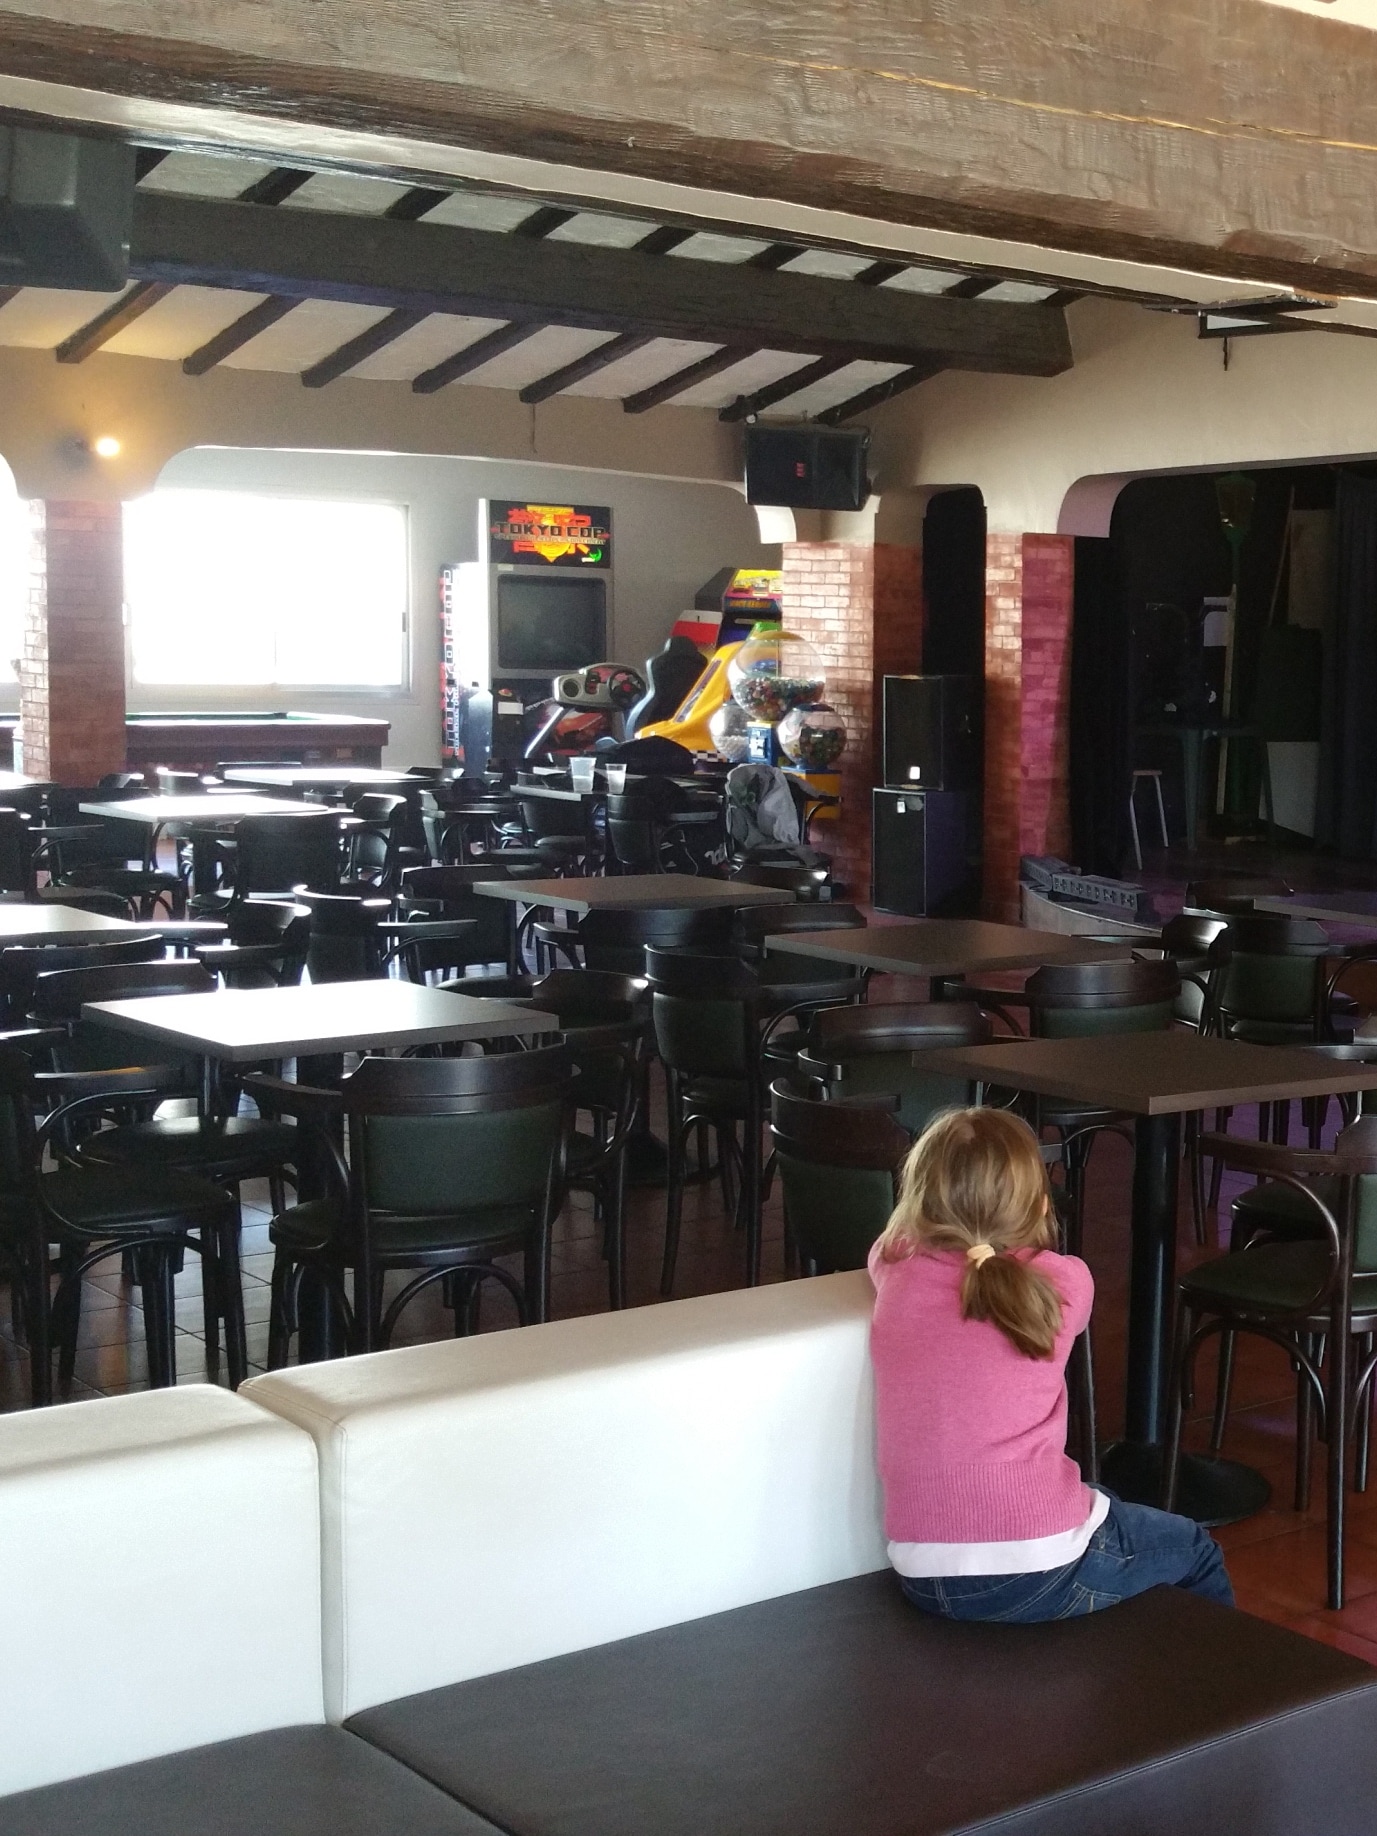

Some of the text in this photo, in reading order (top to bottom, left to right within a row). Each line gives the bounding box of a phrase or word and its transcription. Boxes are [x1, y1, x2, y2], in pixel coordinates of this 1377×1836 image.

[494, 522, 606, 538] TOKYO COP
[444, 642, 455, 750] TOKYO
